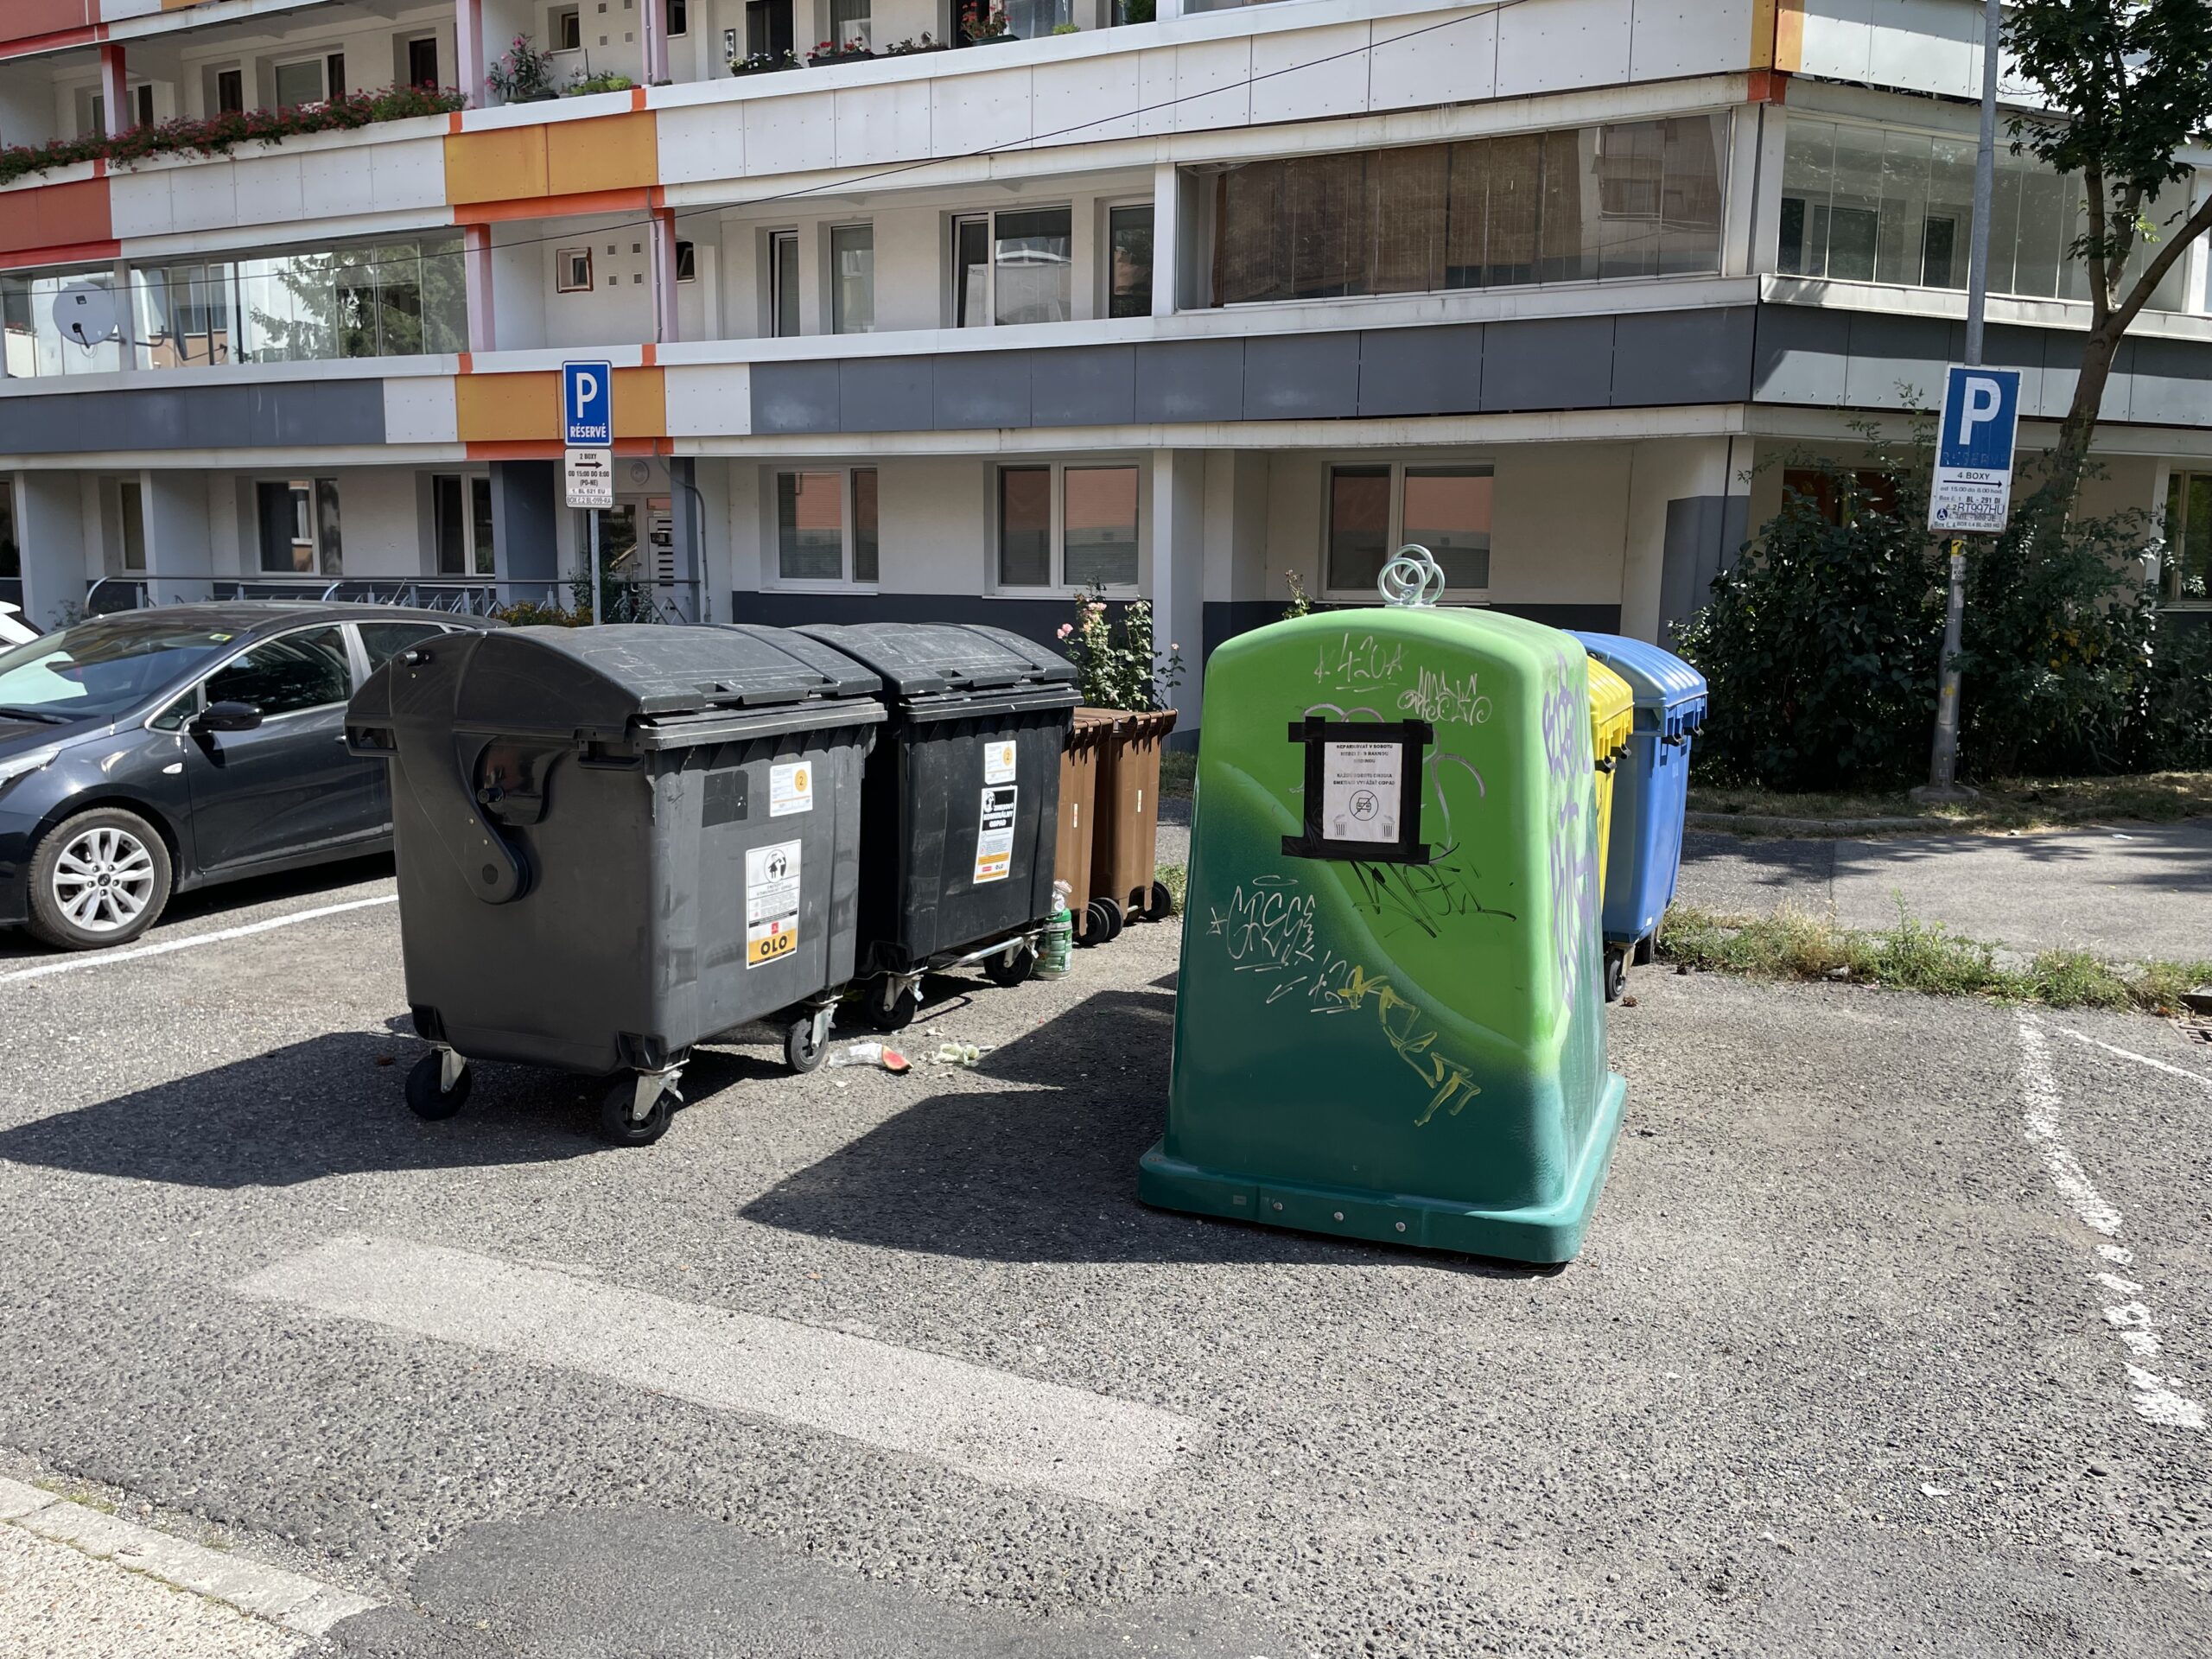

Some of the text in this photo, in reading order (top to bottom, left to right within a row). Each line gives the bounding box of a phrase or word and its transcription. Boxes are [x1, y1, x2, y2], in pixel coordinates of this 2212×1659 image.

[576, 372, 598, 418] P
[1959, 377, 2001, 445] P
[570, 423, 607, 438] RÉSERVÉ
[1966, 472, 1990, 480] BOXY
[1957, 502, 2005, 516] RT997HU
[799, 776, 804, 786] 2
[760, 936, 787, 956] OLO
